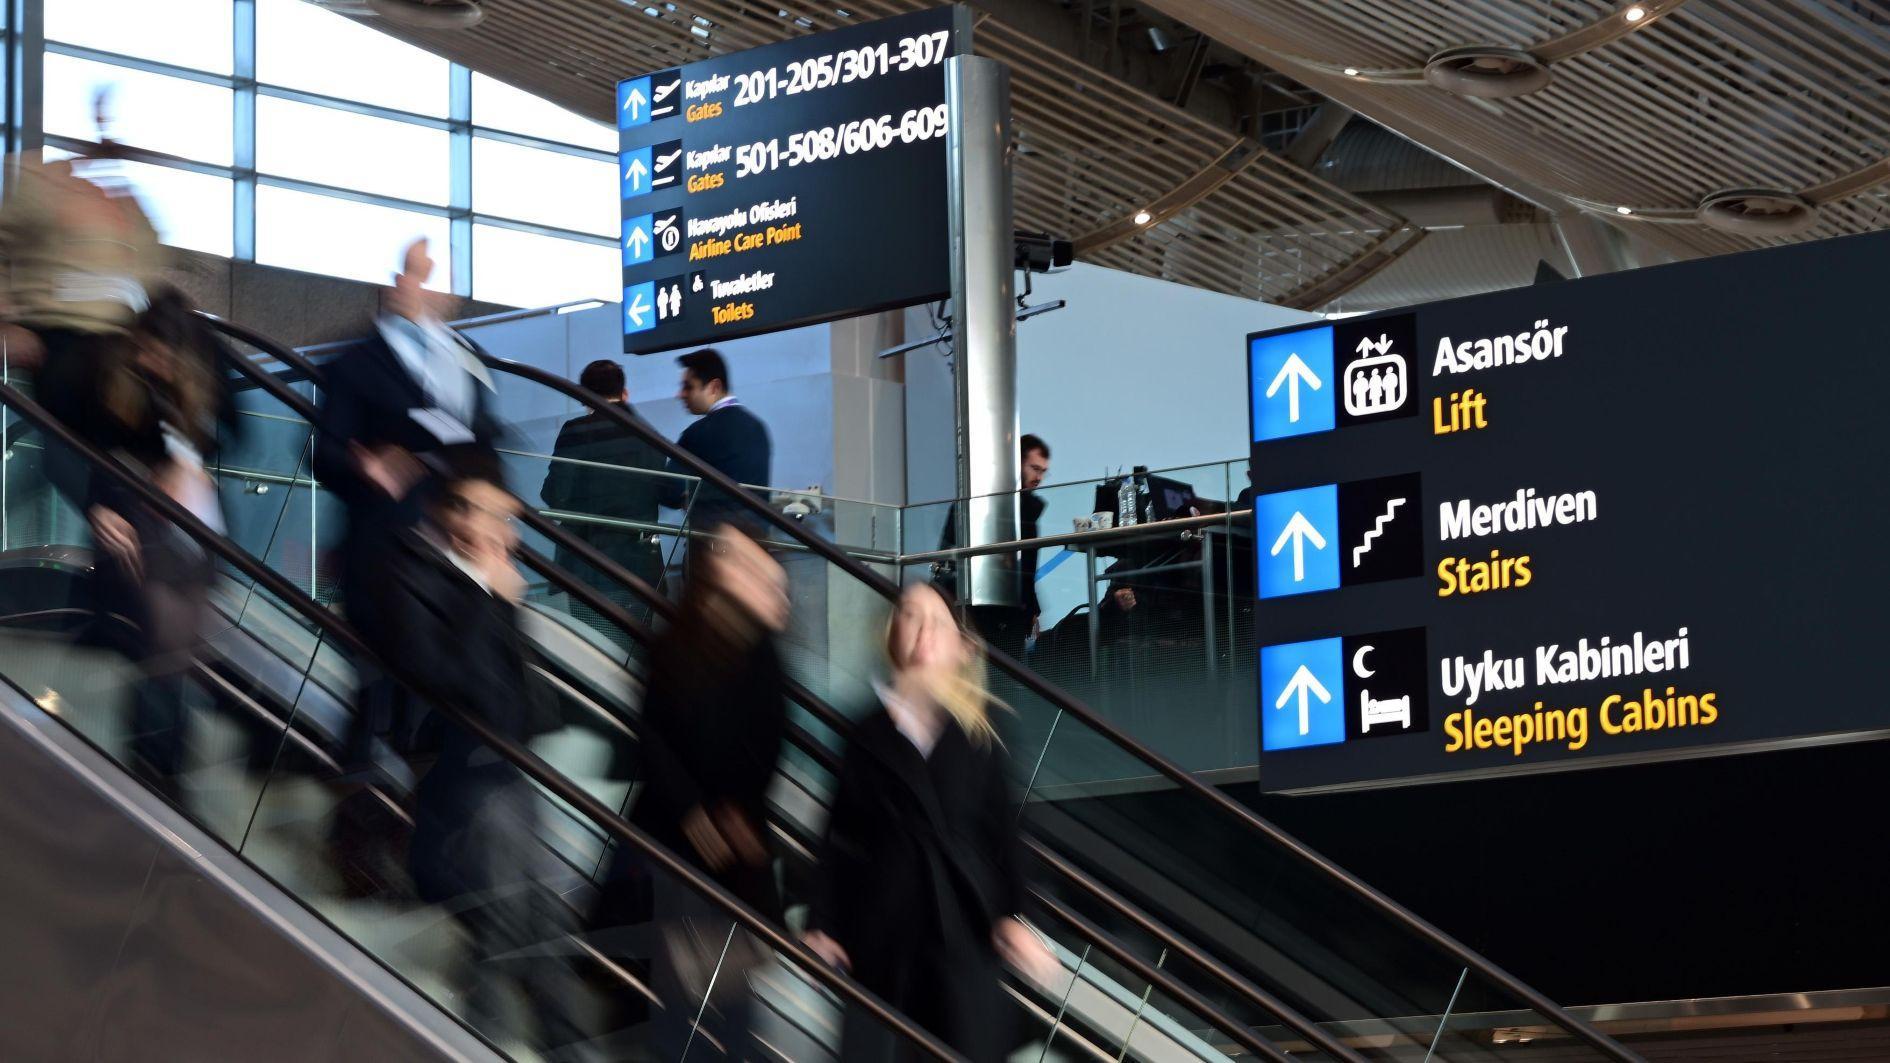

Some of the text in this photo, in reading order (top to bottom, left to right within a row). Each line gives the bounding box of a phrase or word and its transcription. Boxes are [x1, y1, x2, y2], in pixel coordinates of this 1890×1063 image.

[733, 30, 949, 107] 201-205/301-307
[686, 102, 723, 123] Gates
[736, 104, 948, 178] 501-508/606-609
[688, 172, 725, 194] Gates
[689, 223, 802, 262] Airline Care Point
[712, 301, 755, 326] Toilets
[1433, 319, 1568, 376] Asansör
[1433, 388, 1488, 435] Lift
[1439, 488, 1597, 541] Merdiven
[1437, 550, 1532, 597] Stairs
[1441, 627, 1689, 706] Uyku Kabinleri
[1443, 686, 1718, 756] Sleeping Cabins
